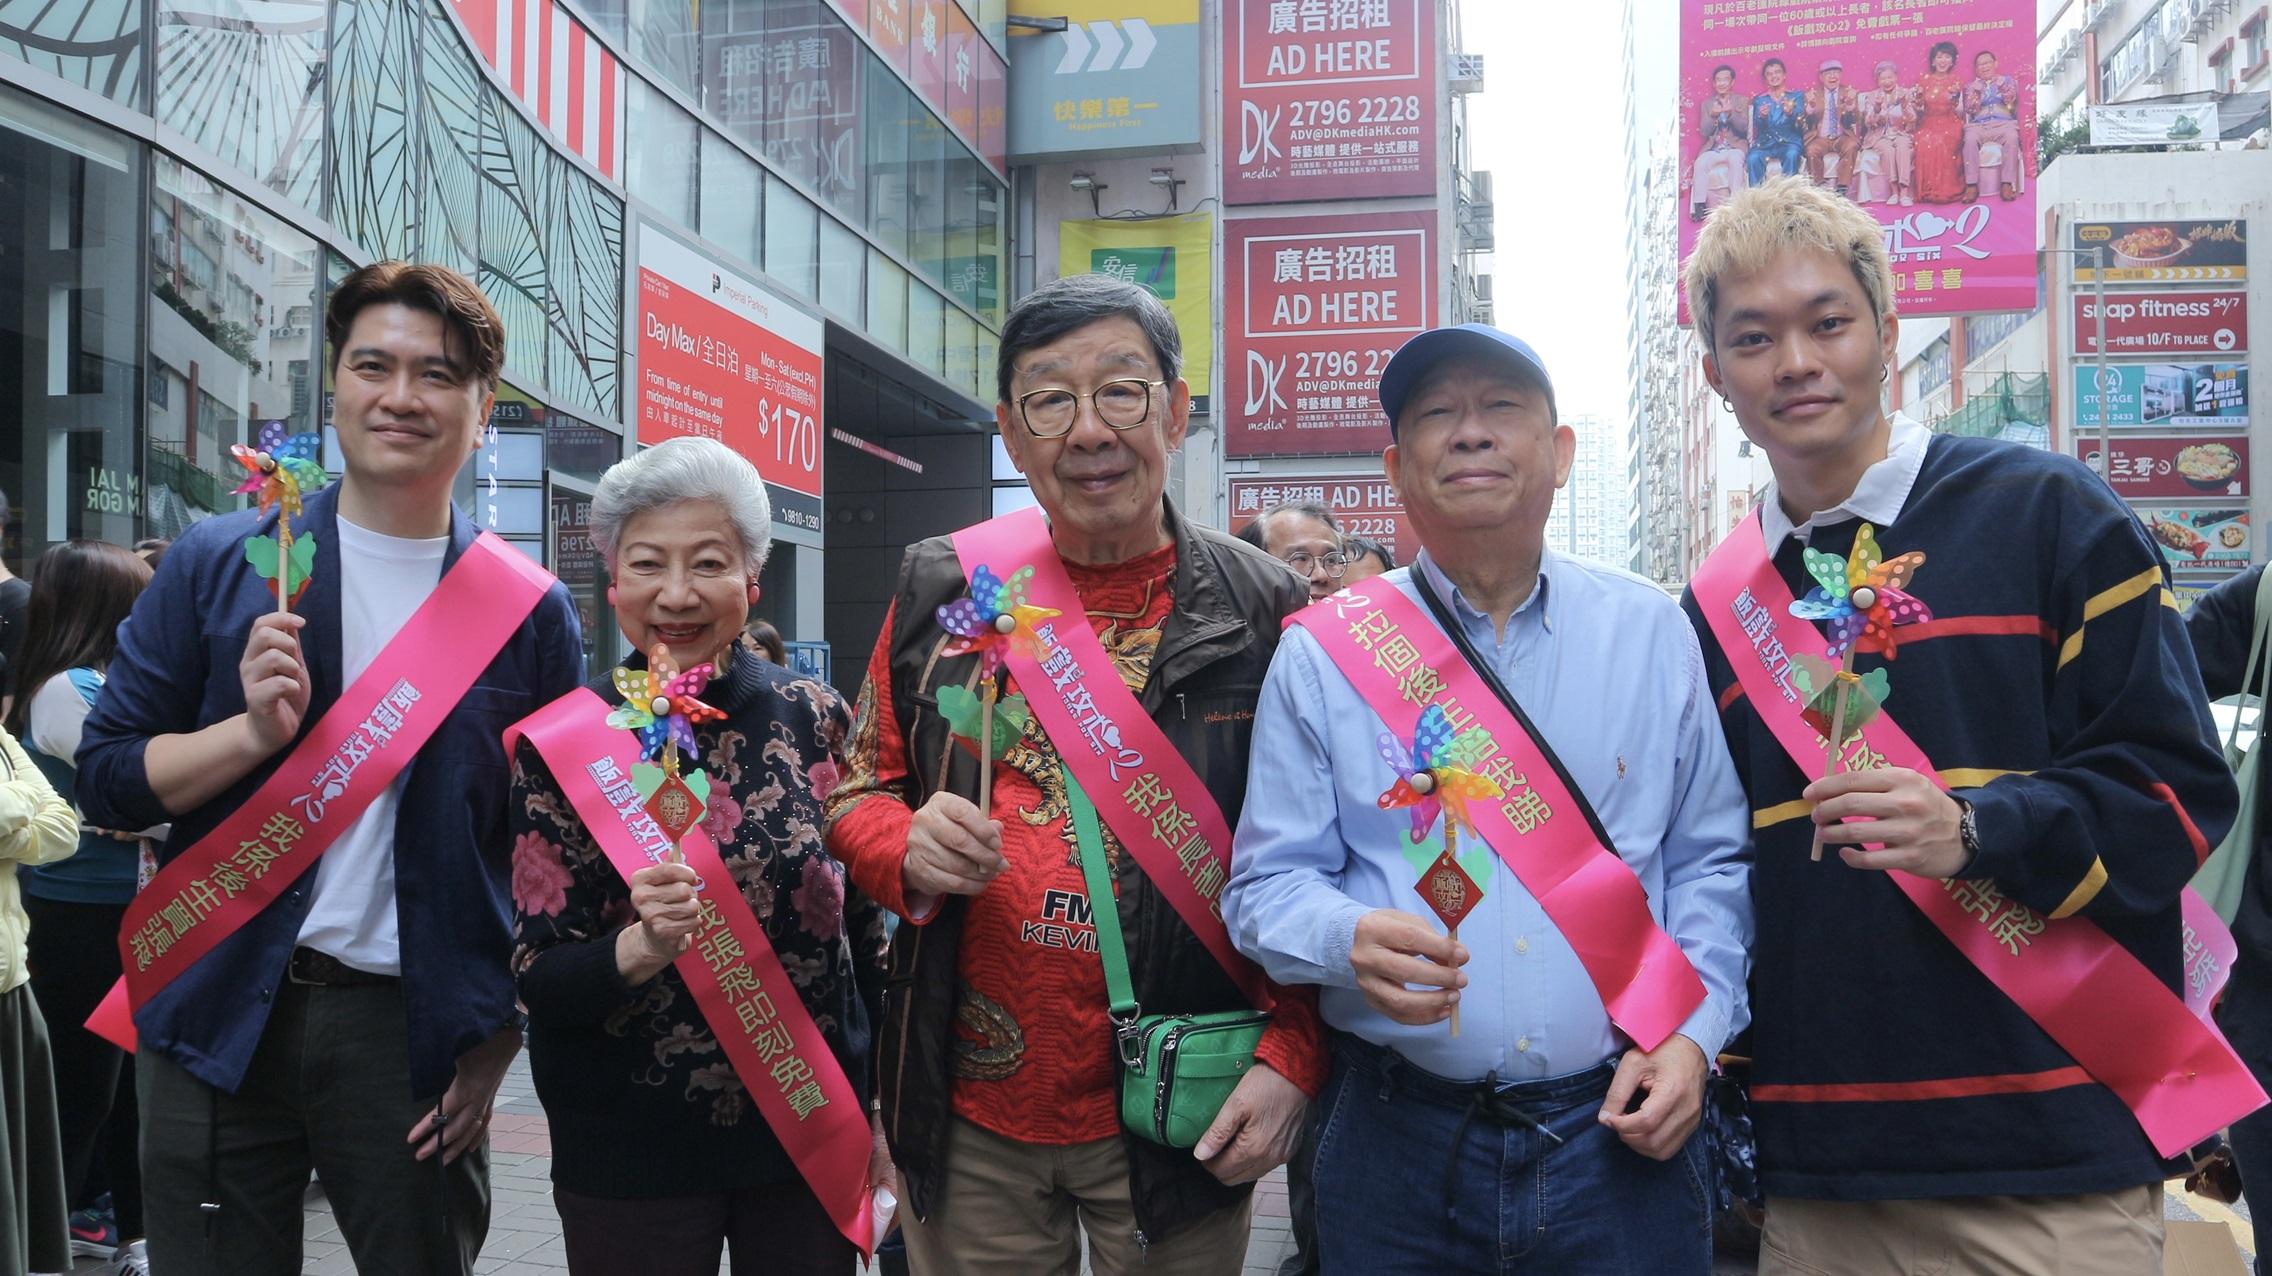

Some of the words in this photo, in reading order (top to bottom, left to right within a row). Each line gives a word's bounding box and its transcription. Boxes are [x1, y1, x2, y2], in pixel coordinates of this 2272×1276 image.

[876, 5, 903, 46] BANK
[1268, 0, 1391, 34] 廣告招租
[1267, 44, 1306, 76] AD
[1315, 39, 1391, 73] HERE
[1054, 97, 1159, 121] 快樂第一
[1290, 99, 1351, 127] 2796
[1358, 95, 1420, 124] 2228
[1290, 125, 1419, 142] ADV@DKmediaHK.com
[1273, 244, 1397, 284] 廣告招租
[1272, 294, 1312, 325] AD
[1321, 290, 1398, 324] HERE
[2139, 298, 2211, 318] fitness
[2213, 297, 2240, 316] 24/7
[646, 311, 670, 350] Day
[672, 322, 695, 356] Max
[702, 335, 739, 377] 全日泊
[2088, 335, 2144, 346] 電一代廣場
[2147, 332, 2171, 346] 10/F
[2184, 334, 2209, 345] PLACE
[1295, 350, 1358, 378] 2796
[646, 368, 664, 387] From
[666, 376, 681, 393] time
[683, 384, 691, 397] of
[692, 389, 709, 406] entry
[646, 389, 675, 410] midnight
[694, 407, 711, 422] same
[2112, 413, 2134, 421] 2433
[1331, 486, 1361, 508] AD
[1367, 484, 1405, 508] HE
[786, 508, 820, 531] 9810-1290
[1350, 518, 1396, 535] 2228
[1121, 772, 1230, 924] 我係長者
[128, 811, 305, 973] 我係後生買張飛
